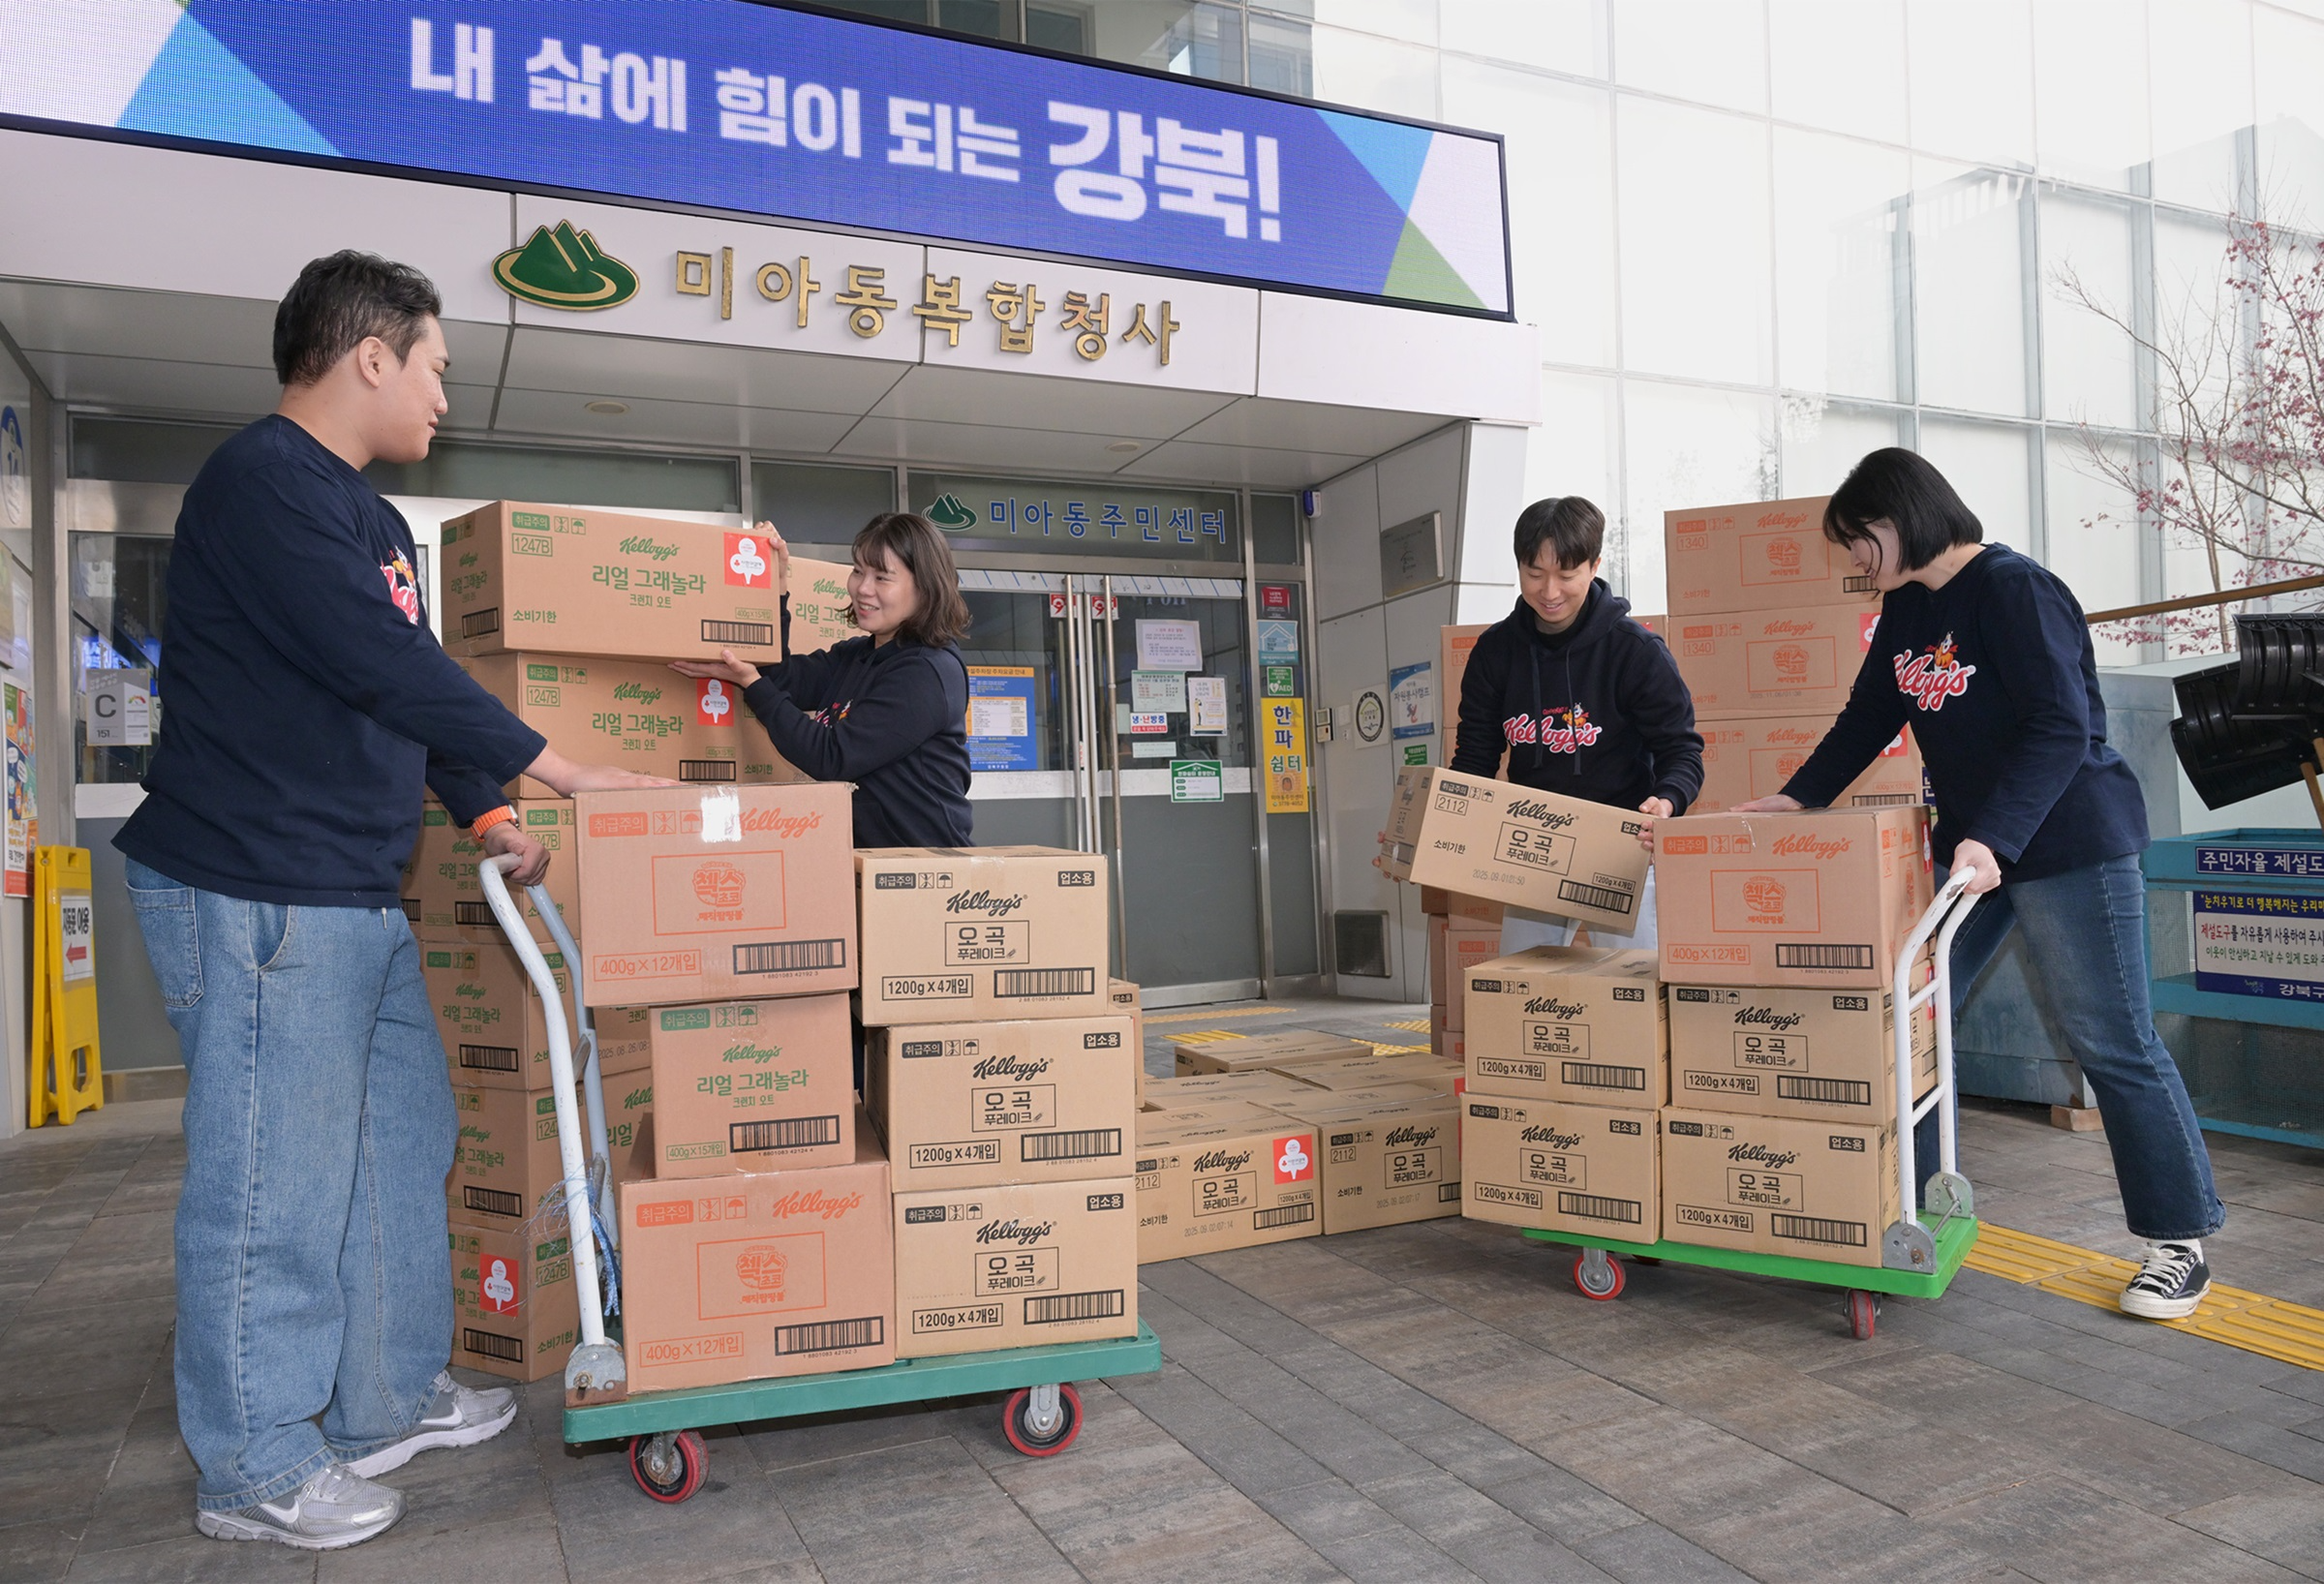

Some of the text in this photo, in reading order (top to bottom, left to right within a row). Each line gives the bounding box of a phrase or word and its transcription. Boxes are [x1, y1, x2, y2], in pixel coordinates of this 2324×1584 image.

[411, 17, 1281, 242] 내 삶에 힘이 되는 강북!
[676, 245, 1179, 366] 미아동복합청사
[515, 514, 549, 529] 취급주의
[989, 496, 1226, 544] 미아동주민센터
[1757, 512, 1809, 528] Kellogg's
[514, 537, 550, 554] 1247B
[620, 535, 680, 561] Kellogg's
[1680, 536, 1705, 549] 1340
[1767, 540, 1801, 558] 첵스
[593, 565, 706, 594] 리얼 그래놀라
[629, 594, 671, 608] 크런치 오트
[1683, 590, 1710, 598] 소비기한
[513, 610, 557, 624] 소비기한
[796, 603, 819, 624] 리얼
[1764, 621, 1816, 635] Kellogg's
[1686, 642, 1711, 654] 1340
[1774, 648, 1807, 664] 첵스
[530, 666, 556, 679] 취급주의
[529, 688, 558, 704] 1247B
[614, 683, 662, 705] Kellogg's
[95, 694, 116, 717] C
[592, 713, 684, 737] 리얼 그래놀라
[1503, 714, 1601, 753] Kellogg's
[1767, 729, 1817, 743] Kellogg's
[623, 739, 657, 750] 크런치 오트
[745, 764, 773, 775] 소비기한
[1441, 782, 1467, 794] 취급주의
[1438, 798, 1465, 813] 2112
[1508, 800, 1575, 829] Kellogg's
[593, 816, 645, 833] 취급주의
[1434, 839, 1466, 854] 소비기한
[1667, 838, 1704, 852] 취급주의
[1773, 834, 1850, 859] Kellogg's
[1507, 848, 1549, 866] 푸레이크
[2203, 851, 2268, 871] 주민자율
[439, 864, 456, 879] 리얼
[1060, 872, 1092, 885] 업소용
[695, 871, 743, 896] 첵스
[878, 875, 913, 886] 취급주의
[1746, 882, 1784, 900] 첵스
[946, 890, 1023, 916] Kellogg's
[2247, 898, 2254, 908] 더
[2256, 898, 2298, 912] 행복해지는
[2201, 923, 2238, 941] 제설도구를
[2241, 927, 2272, 942] 자유롭게
[2275, 928, 2307, 945] 사용하여
[958, 948, 1005, 960] 푸레이크
[2206, 946, 2226, 959] 이웃이
[2229, 948, 2257, 960] 안심하고
[2259, 951, 2274, 963] 지날
[2276, 953, 2283, 962] 수
[2286, 953, 2301, 964] 있게
[2303, 955, 2318, 966] 도와
[1474, 982, 1500, 990] 취급주의
[1615, 990, 1643, 1000] 업소용
[1679, 991, 1708, 1000] 취급주의
[1524, 996, 1583, 1020] Kellogg's
[1835, 997, 1866, 1010] 업소용
[443, 1006, 501, 1023] 리얼 그래놀라
[665, 1013, 707, 1026] 취급주의
[1734, 1006, 1799, 1030] Kellogg's
[1086, 1035, 1118, 1047] 업소용
[1533, 1043, 1571, 1053] 푸레이크
[722, 1044, 782, 1064] Kellogg's
[905, 1044, 941, 1056] 취급주의
[1745, 1054, 1787, 1066] 푸레이크
[973, 1055, 1048, 1081] Kellogg's
[697, 1069, 809, 1096] 리얼 그래놀라
[732, 1094, 775, 1108] 크런치 오트
[984, 1112, 1032, 1126] 푸레이크
[1472, 1107, 1497, 1117] 취급주의
[1611, 1121, 1639, 1134] 업소용
[1672, 1123, 1701, 1134] 취급주의
[1386, 1126, 1437, 1147] Kellogg's
[1521, 1125, 1580, 1149] Kellogg's
[1832, 1138, 1863, 1151] 업소용
[468, 1147, 505, 1167] 그래놀라
[1194, 1151, 1250, 1173] Kellogg's
[1332, 1149, 1354, 1162] 2112
[1728, 1142, 1795, 1169] Kellogg's
[1393, 1171, 1426, 1183] 푸레이크
[1530, 1170, 1567, 1183] 푸레이크
[1337, 1185, 1363, 1198] 소비기한
[1738, 1191, 1781, 1204] 푸레이크
[773, 1190, 861, 1220] Kellogg's
[1089, 1196, 1122, 1209] 업소용
[1203, 1196, 1239, 1210] 푸레이크
[641, 1204, 690, 1223] 취급주의
[908, 1209, 943, 1221] 취급주의
[1140, 1214, 1168, 1227] 소비기한
[976, 1219, 1052, 1245] Kellogg's
[740, 1255, 784, 1278] 첵스
[988, 1276, 1035, 1290] 푸레이크
[537, 1331, 573, 1353] 소비기한
